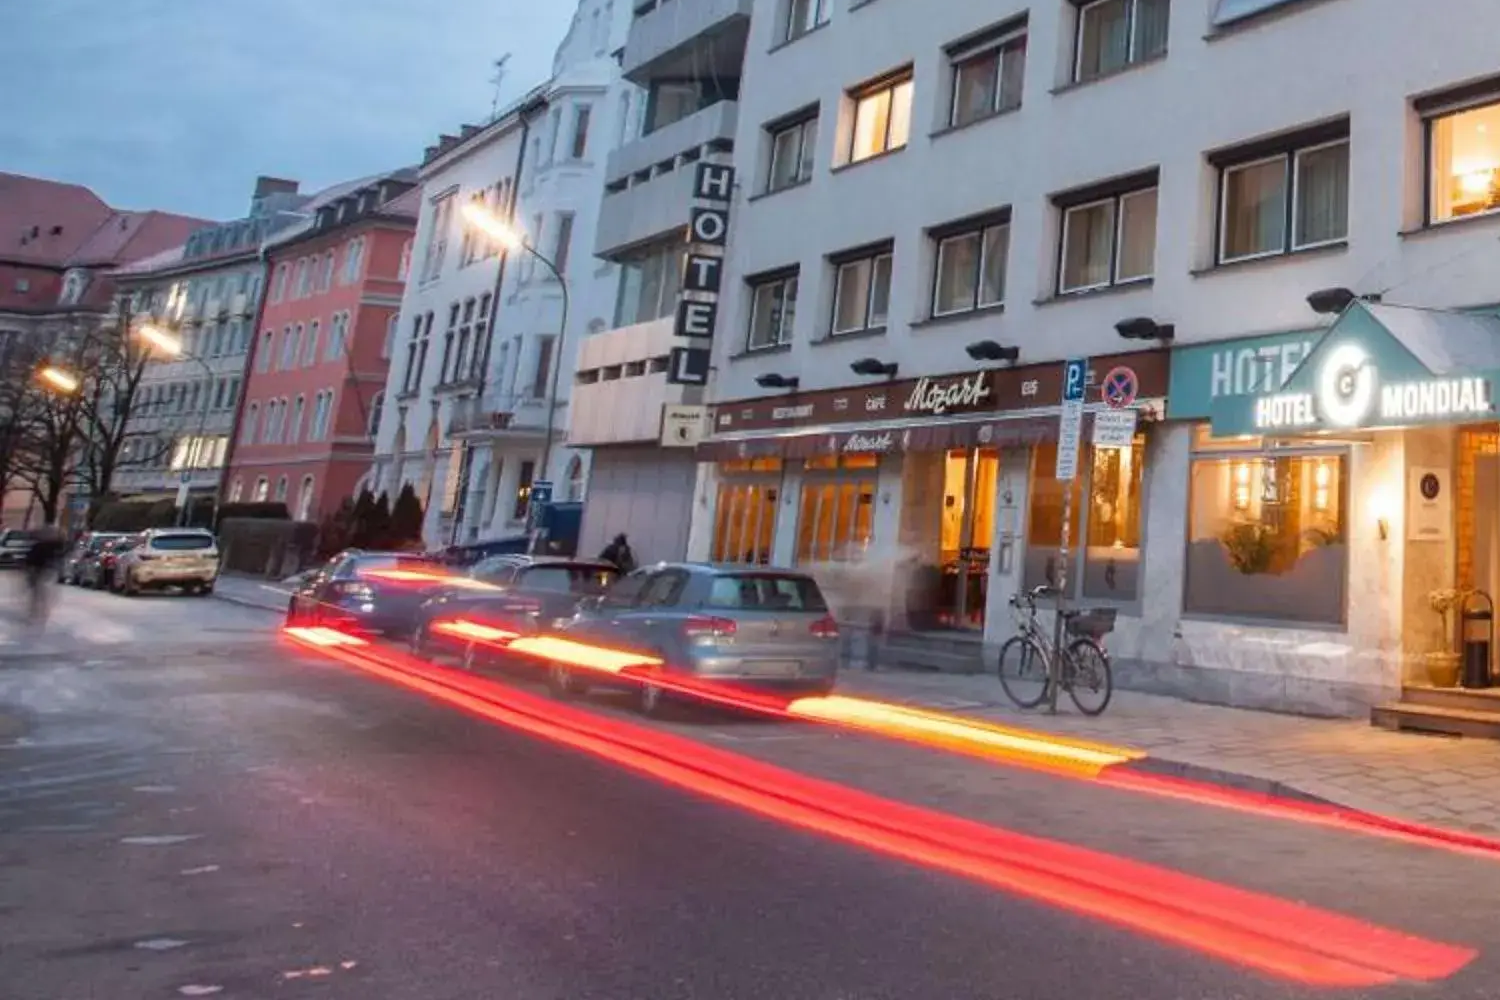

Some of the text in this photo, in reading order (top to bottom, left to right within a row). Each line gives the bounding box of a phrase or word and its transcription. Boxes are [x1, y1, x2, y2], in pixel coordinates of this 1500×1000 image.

[677, 165, 729, 382] HOTEL
[904, 370, 990, 414] Mozart
[1256, 377, 1490, 428] HOTEL MONDIAL
